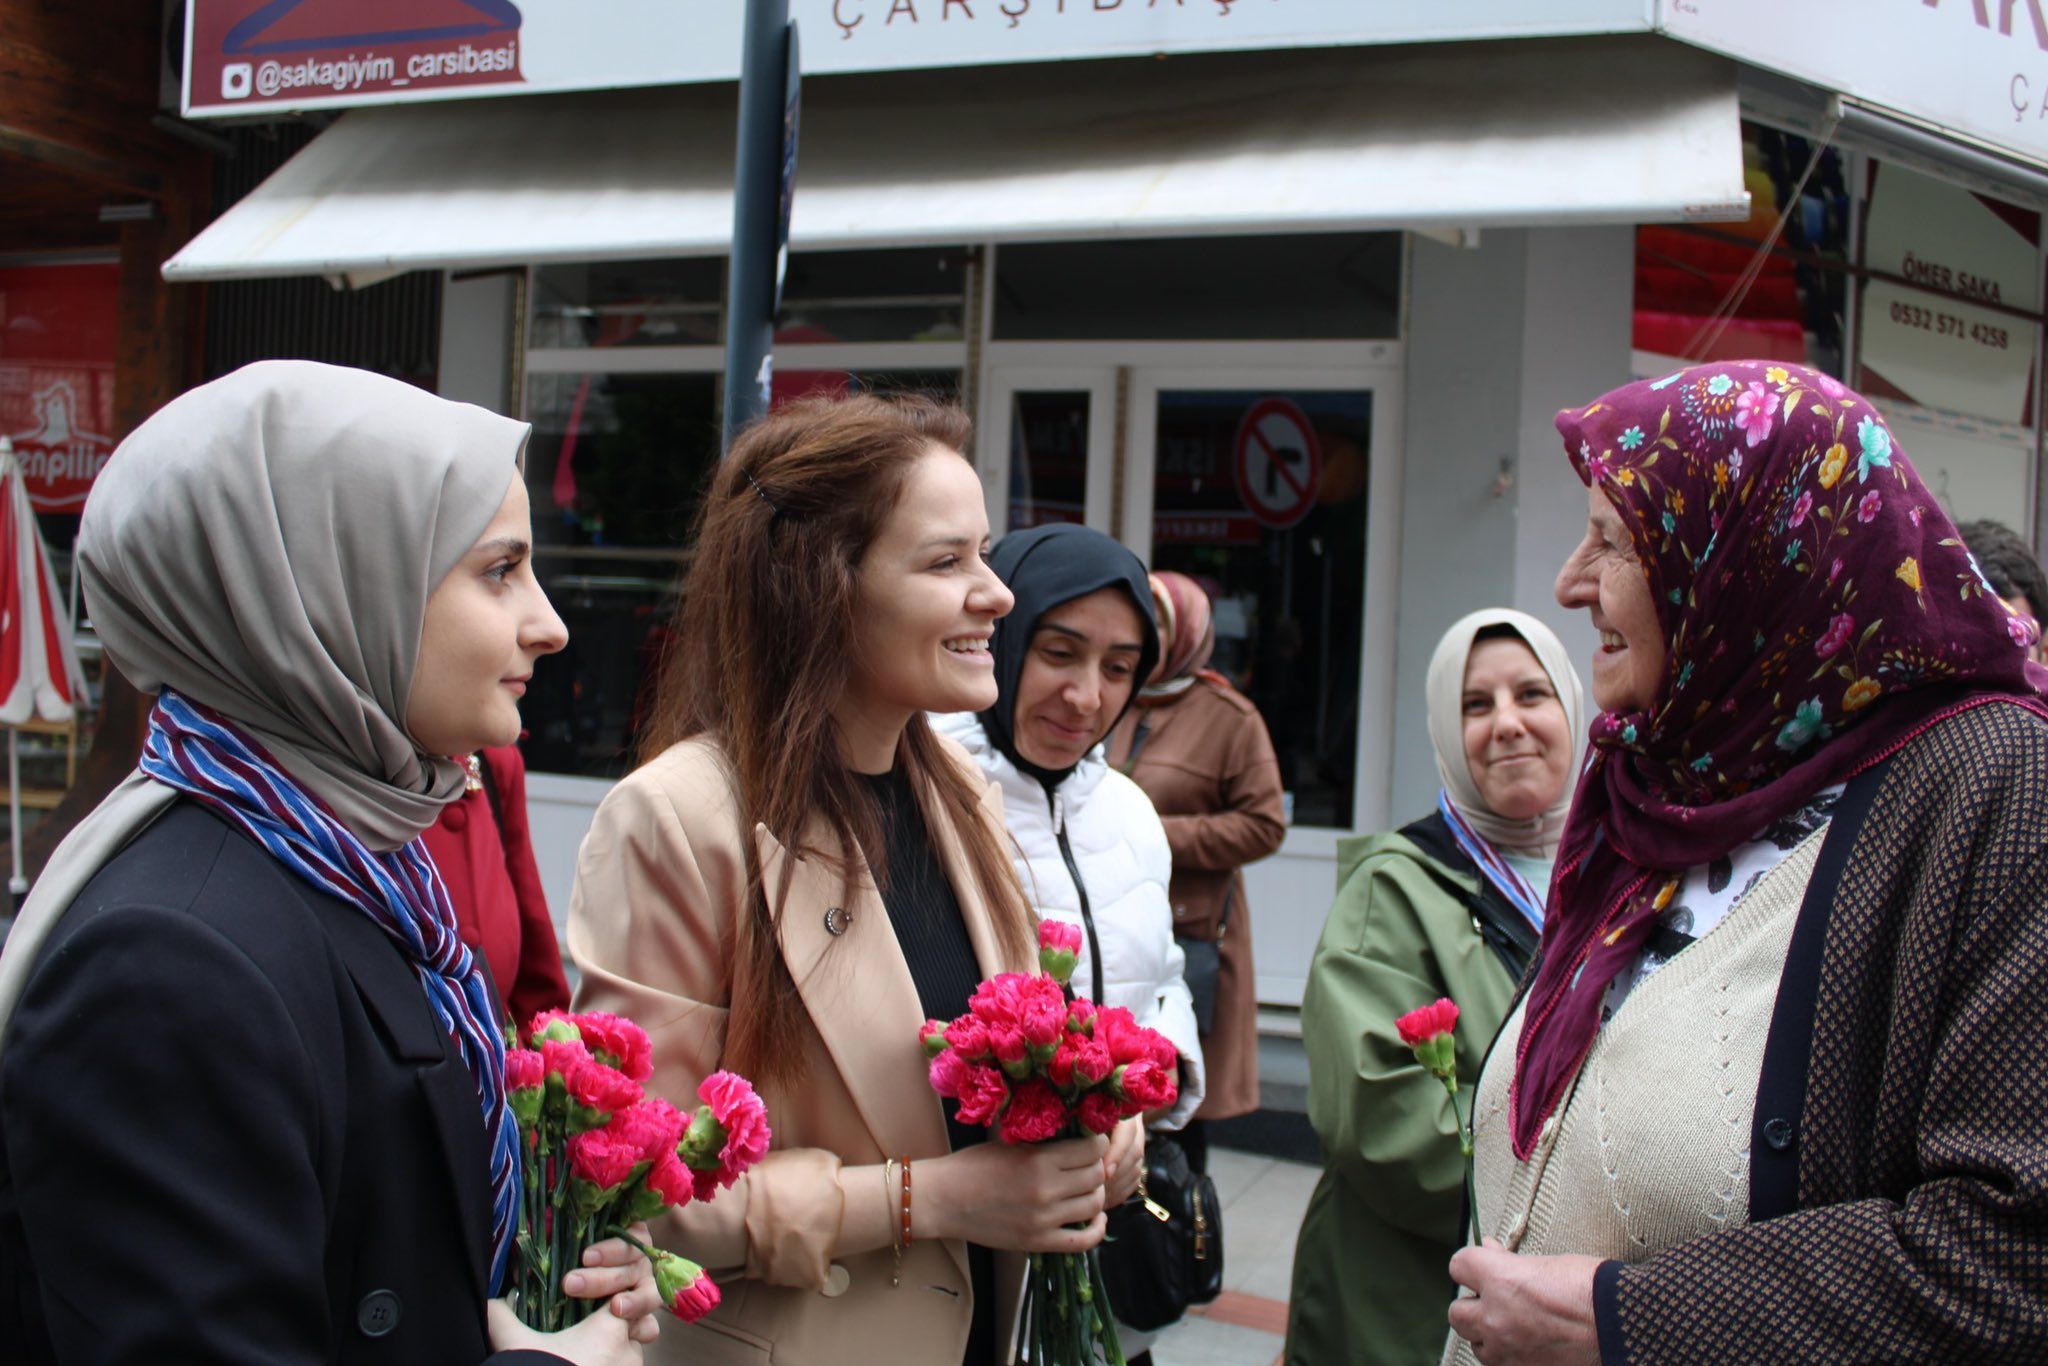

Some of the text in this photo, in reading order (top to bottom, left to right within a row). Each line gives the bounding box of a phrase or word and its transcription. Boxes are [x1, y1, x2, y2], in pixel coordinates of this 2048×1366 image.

[256, 41, 516, 97] @sakagiyim_carsibasi
[1902, 250, 2002, 303] ÖMER SAKA
[1890, 300, 2009, 350] 0532 571 4258
[18, 443, 108, 487] enpili
